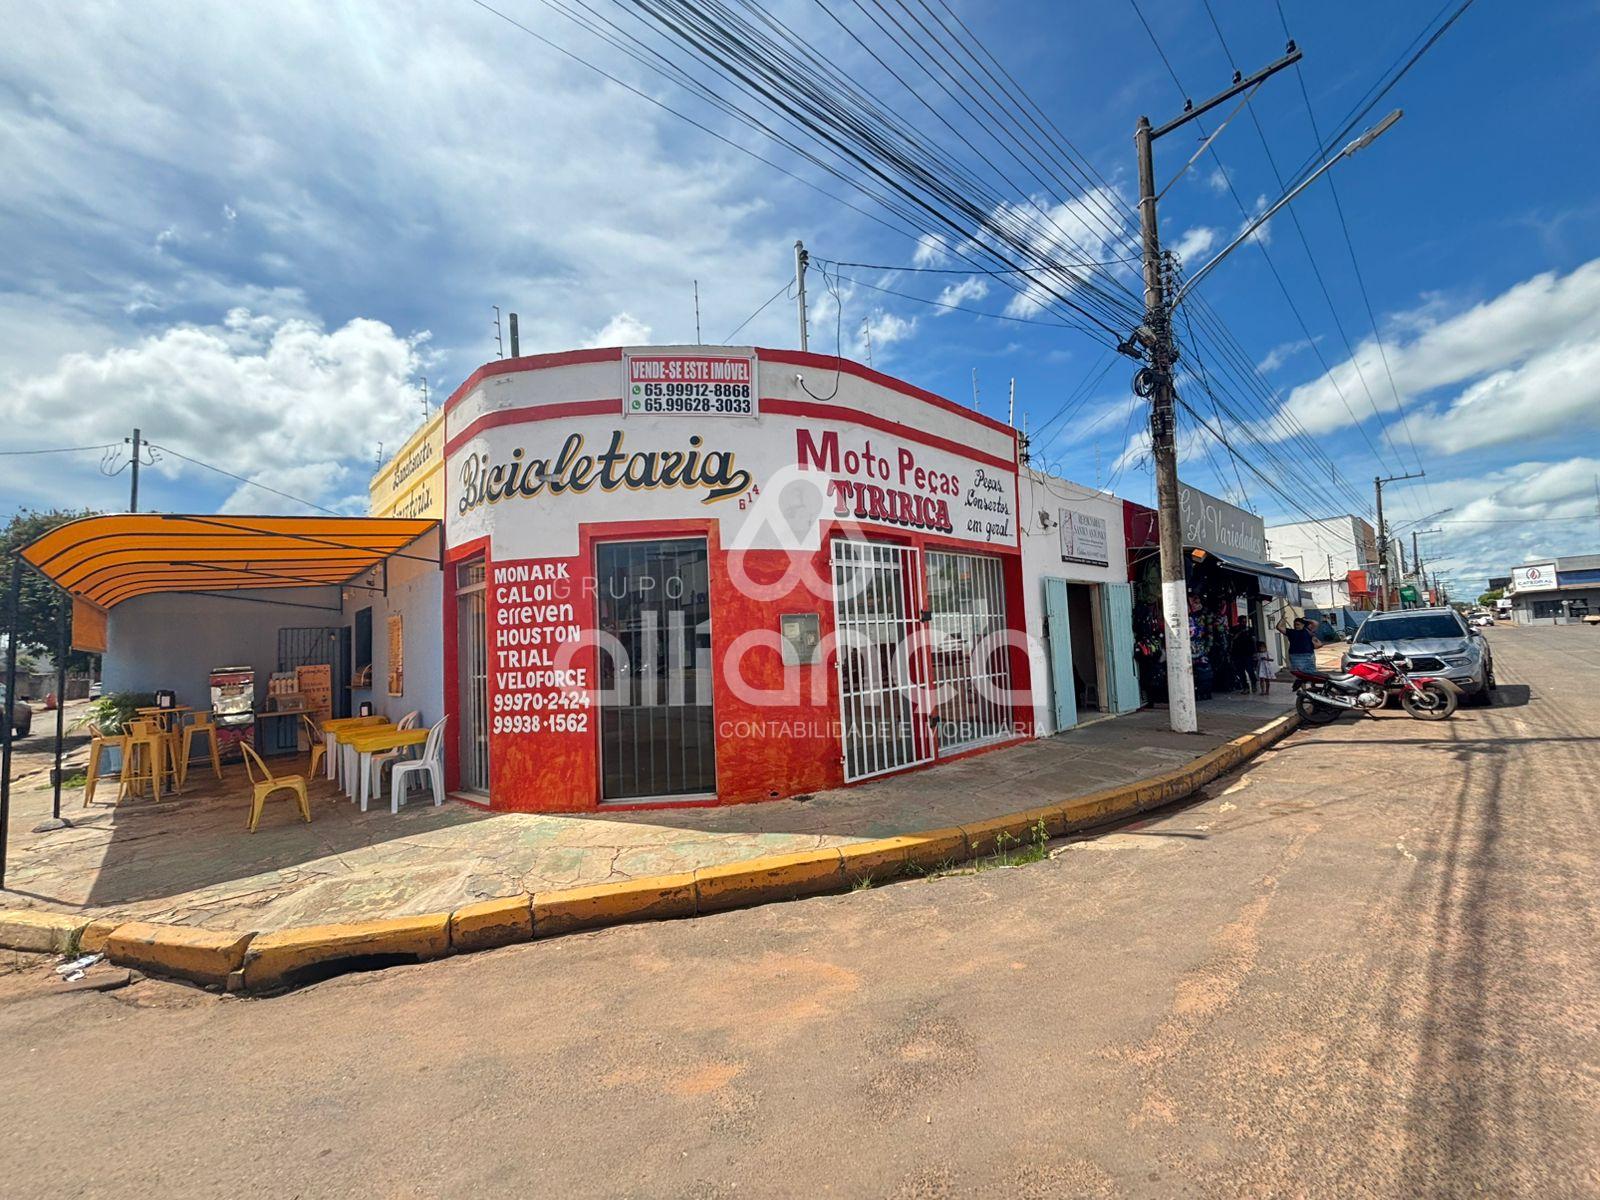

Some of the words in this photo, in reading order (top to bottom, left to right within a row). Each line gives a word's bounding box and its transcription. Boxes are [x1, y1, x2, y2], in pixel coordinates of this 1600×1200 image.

[632, 361, 683, 380] VENDE-SE
[684, 361, 709, 380] ESTE
[711, 360, 749, 380] IMÓVEL
[645, 383, 750, 398] 65.99912-8868
[645, 398, 751, 413] 65.99628-3033
[459, 430, 751, 514] Bicicletaria
[796, 429, 890, 481] Moto
[898, 447, 960, 496] Peças
[974, 469, 1004, 492] Peças
[827, 479, 953, 533] TIRIRICA
[964, 489, 1010, 515] Consertos
[967, 520, 982, 532] em
[1206, 505, 1261, 554] Variedades
[494, 563, 570, 584] MONARK
[496, 585, 552, 604] CALOI
[496, 625, 581, 647] HOUSTON
[497, 649, 553, 668] TRIAL
[496, 668, 586, 689] VELOFORCE
